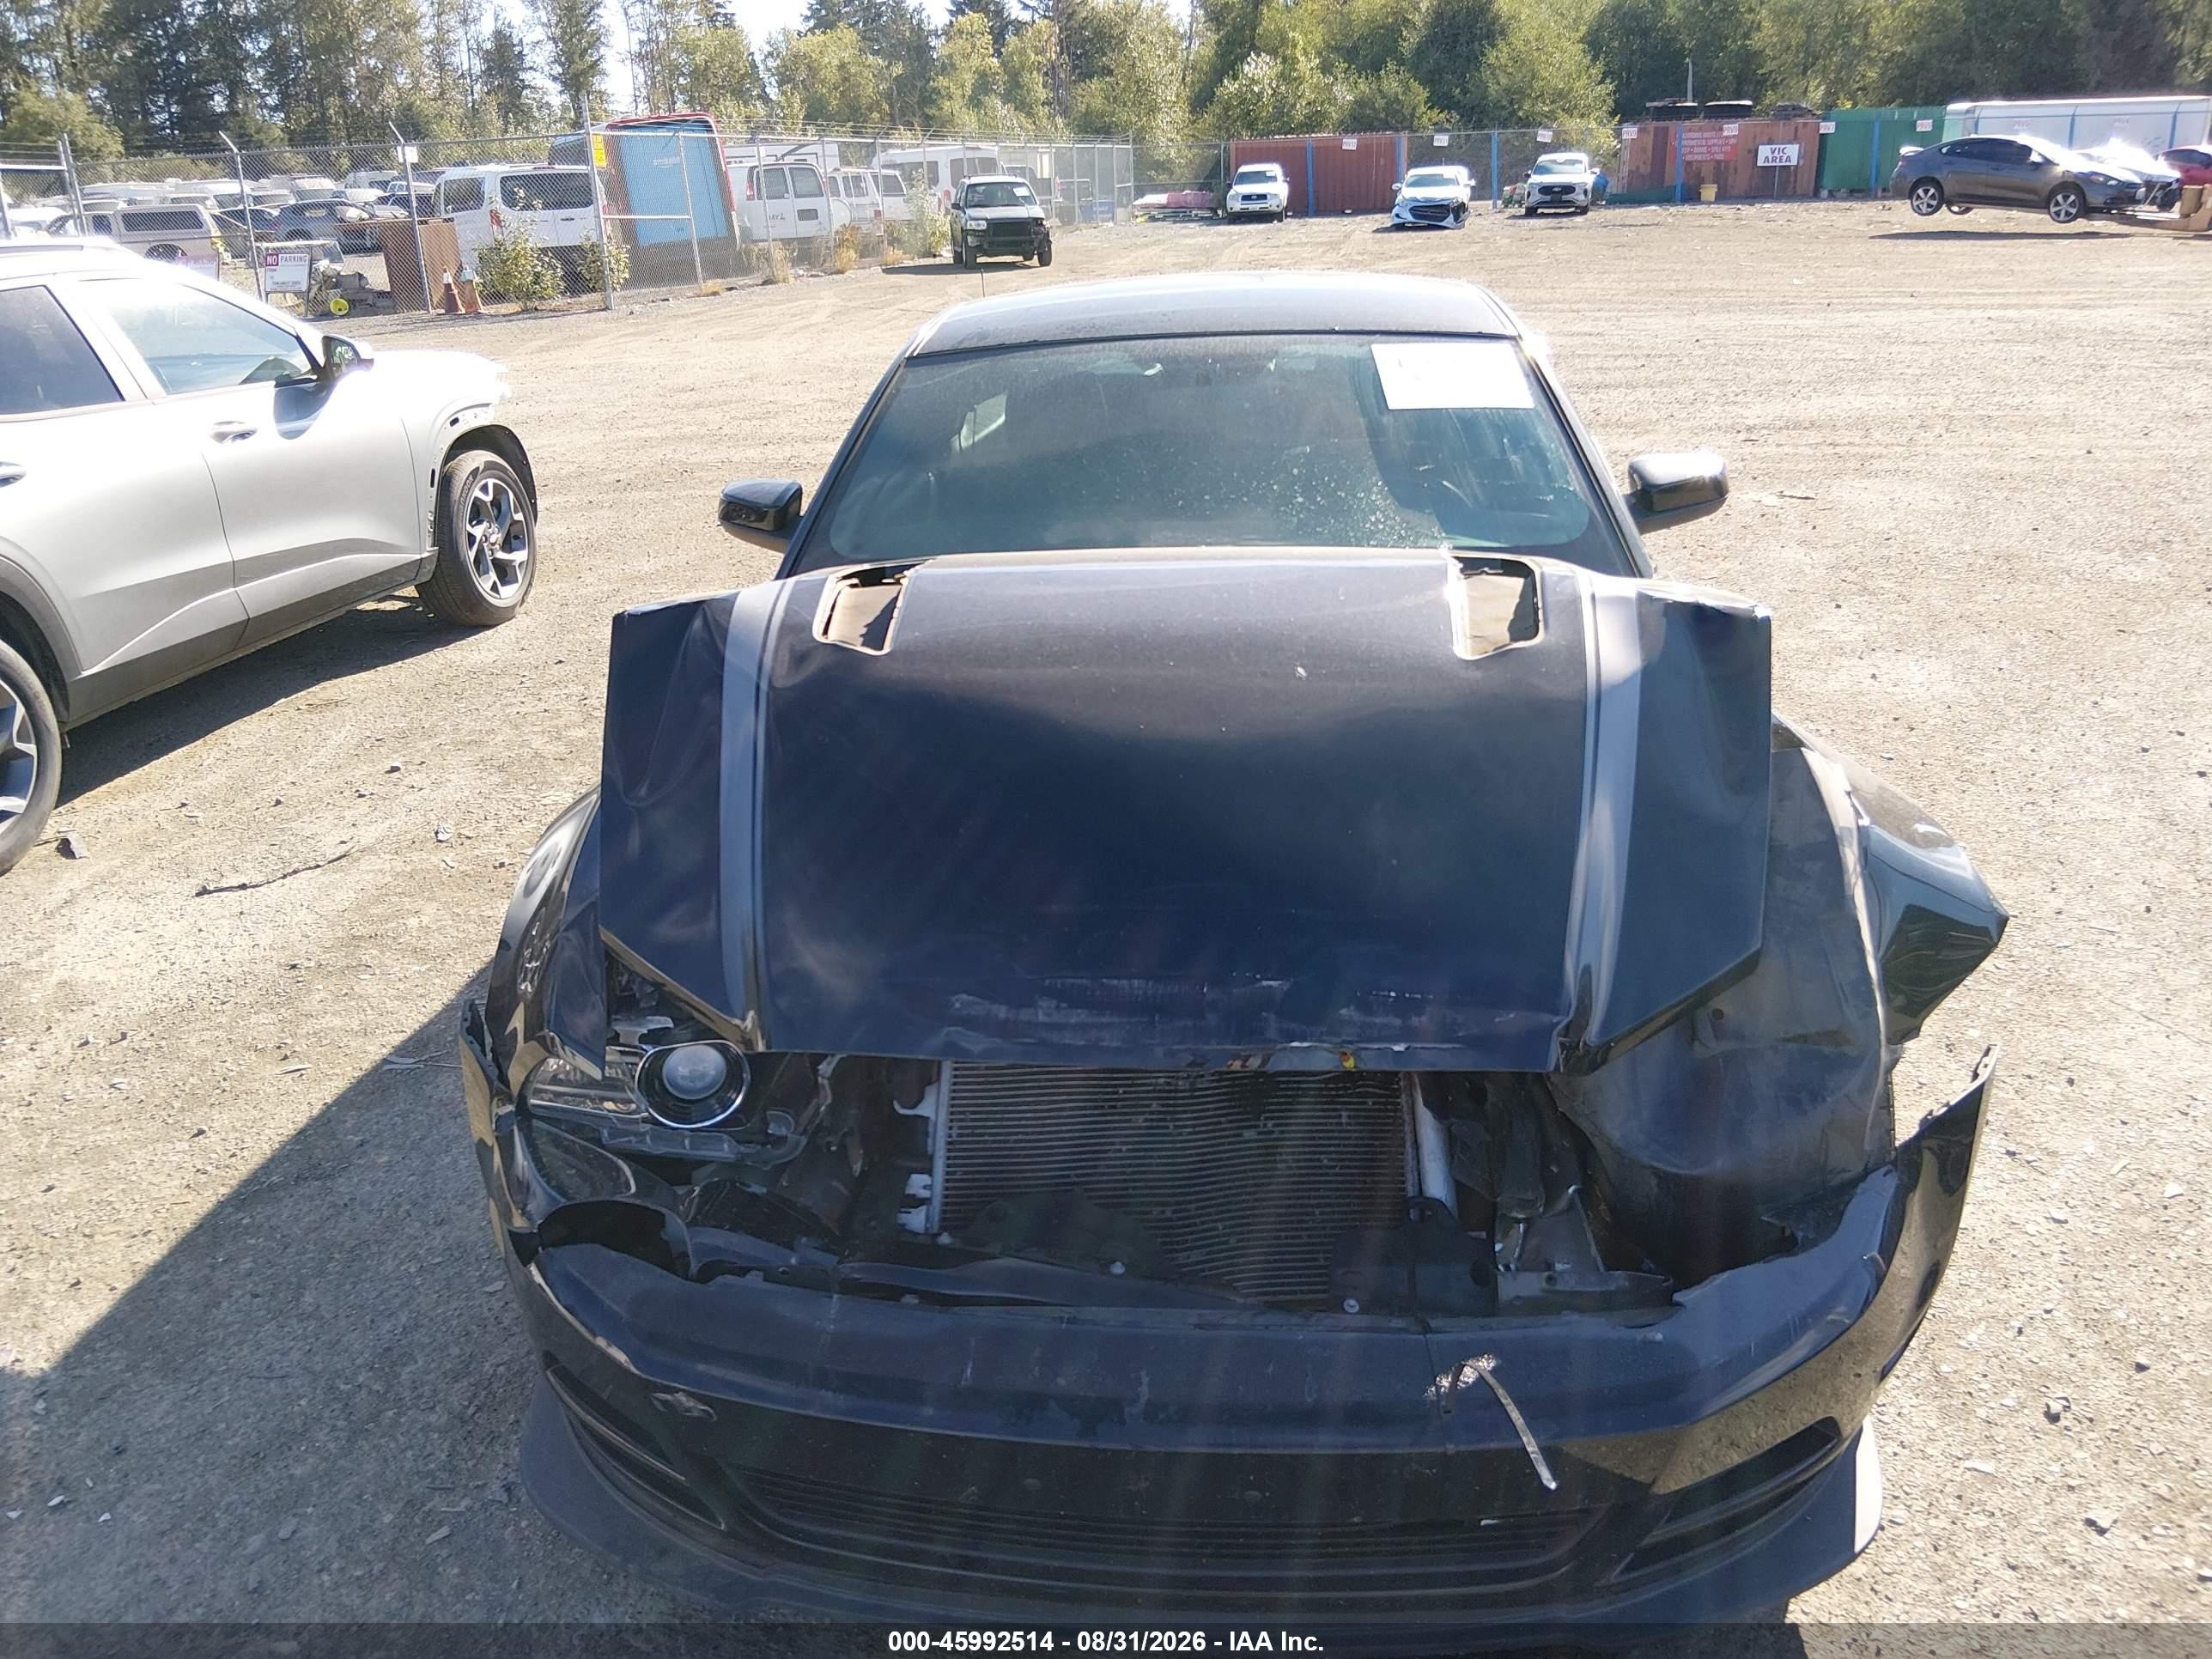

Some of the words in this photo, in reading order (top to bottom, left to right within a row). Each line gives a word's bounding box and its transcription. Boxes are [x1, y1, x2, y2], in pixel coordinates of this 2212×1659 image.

[1771, 146, 1788, 155] VIC
[1763, 155, 1791, 164] AREA
[267, 255, 277, 265] NO
